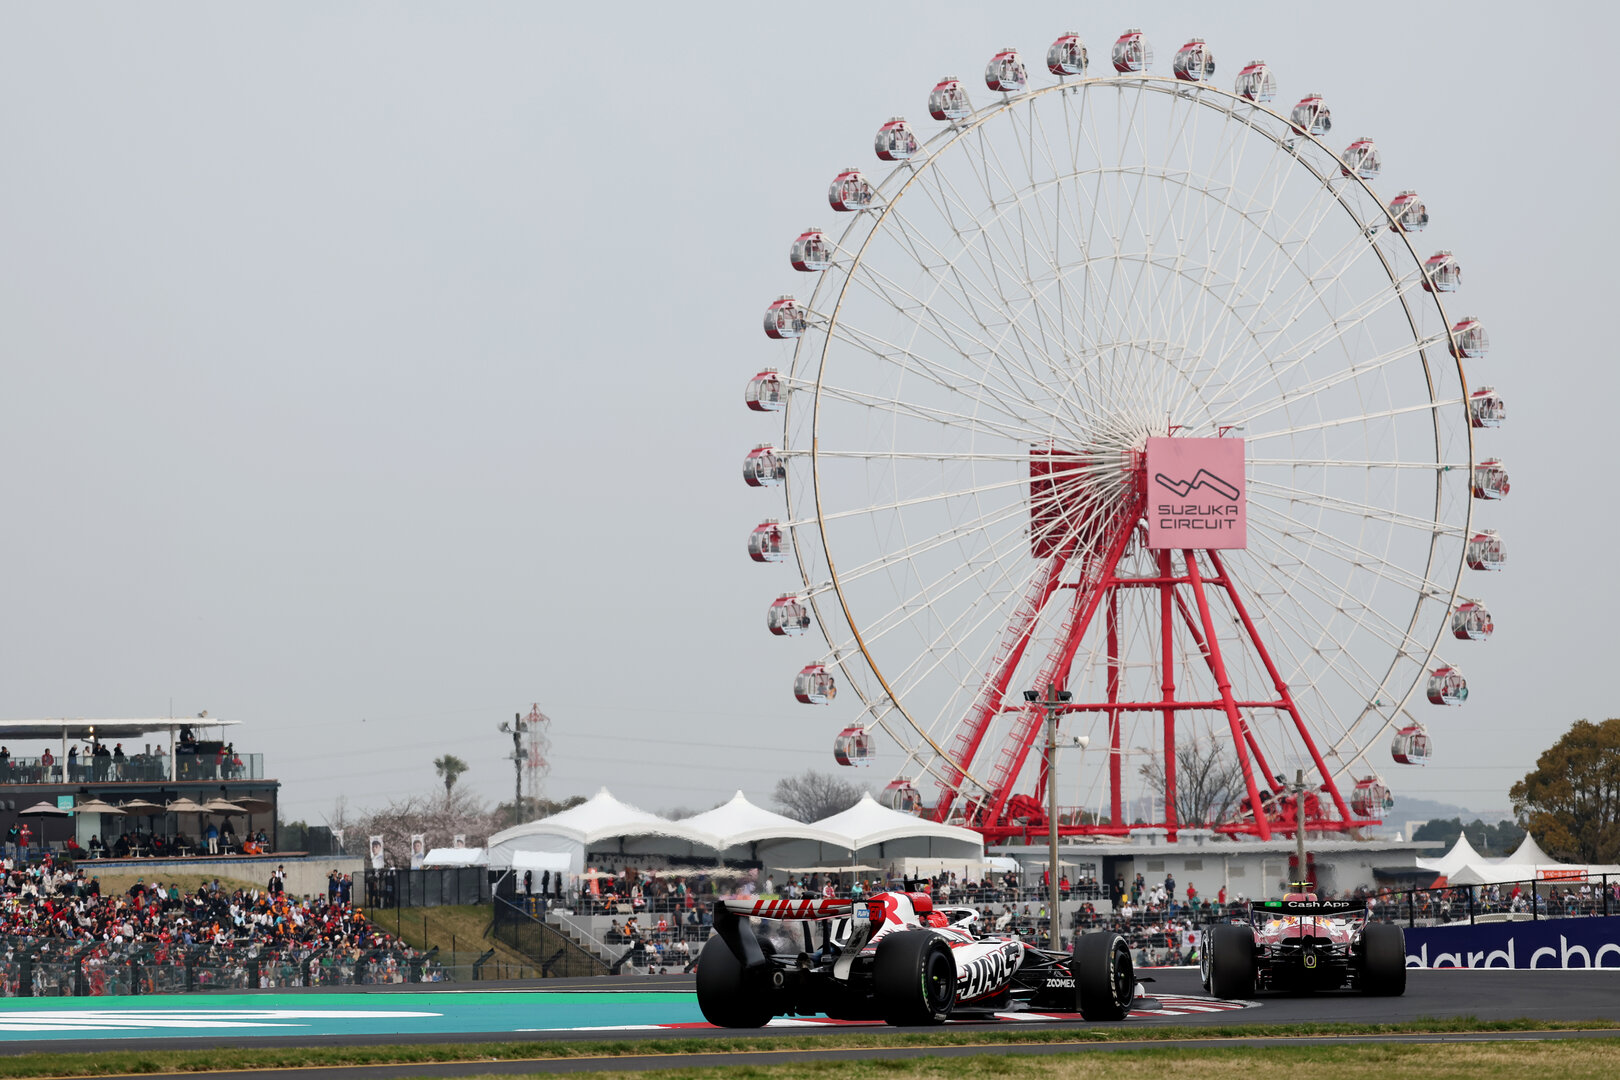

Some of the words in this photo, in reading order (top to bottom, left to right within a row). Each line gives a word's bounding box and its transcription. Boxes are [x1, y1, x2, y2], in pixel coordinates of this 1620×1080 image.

[1158, 504, 1239, 516] SUZUKA
[1160, 519, 1237, 529] CIRCUIT
[750, 899, 853, 919] HAAS
[1046, 978, 1076, 988] ZOOMEX
[1110, 962, 1118, 998] ZERO
